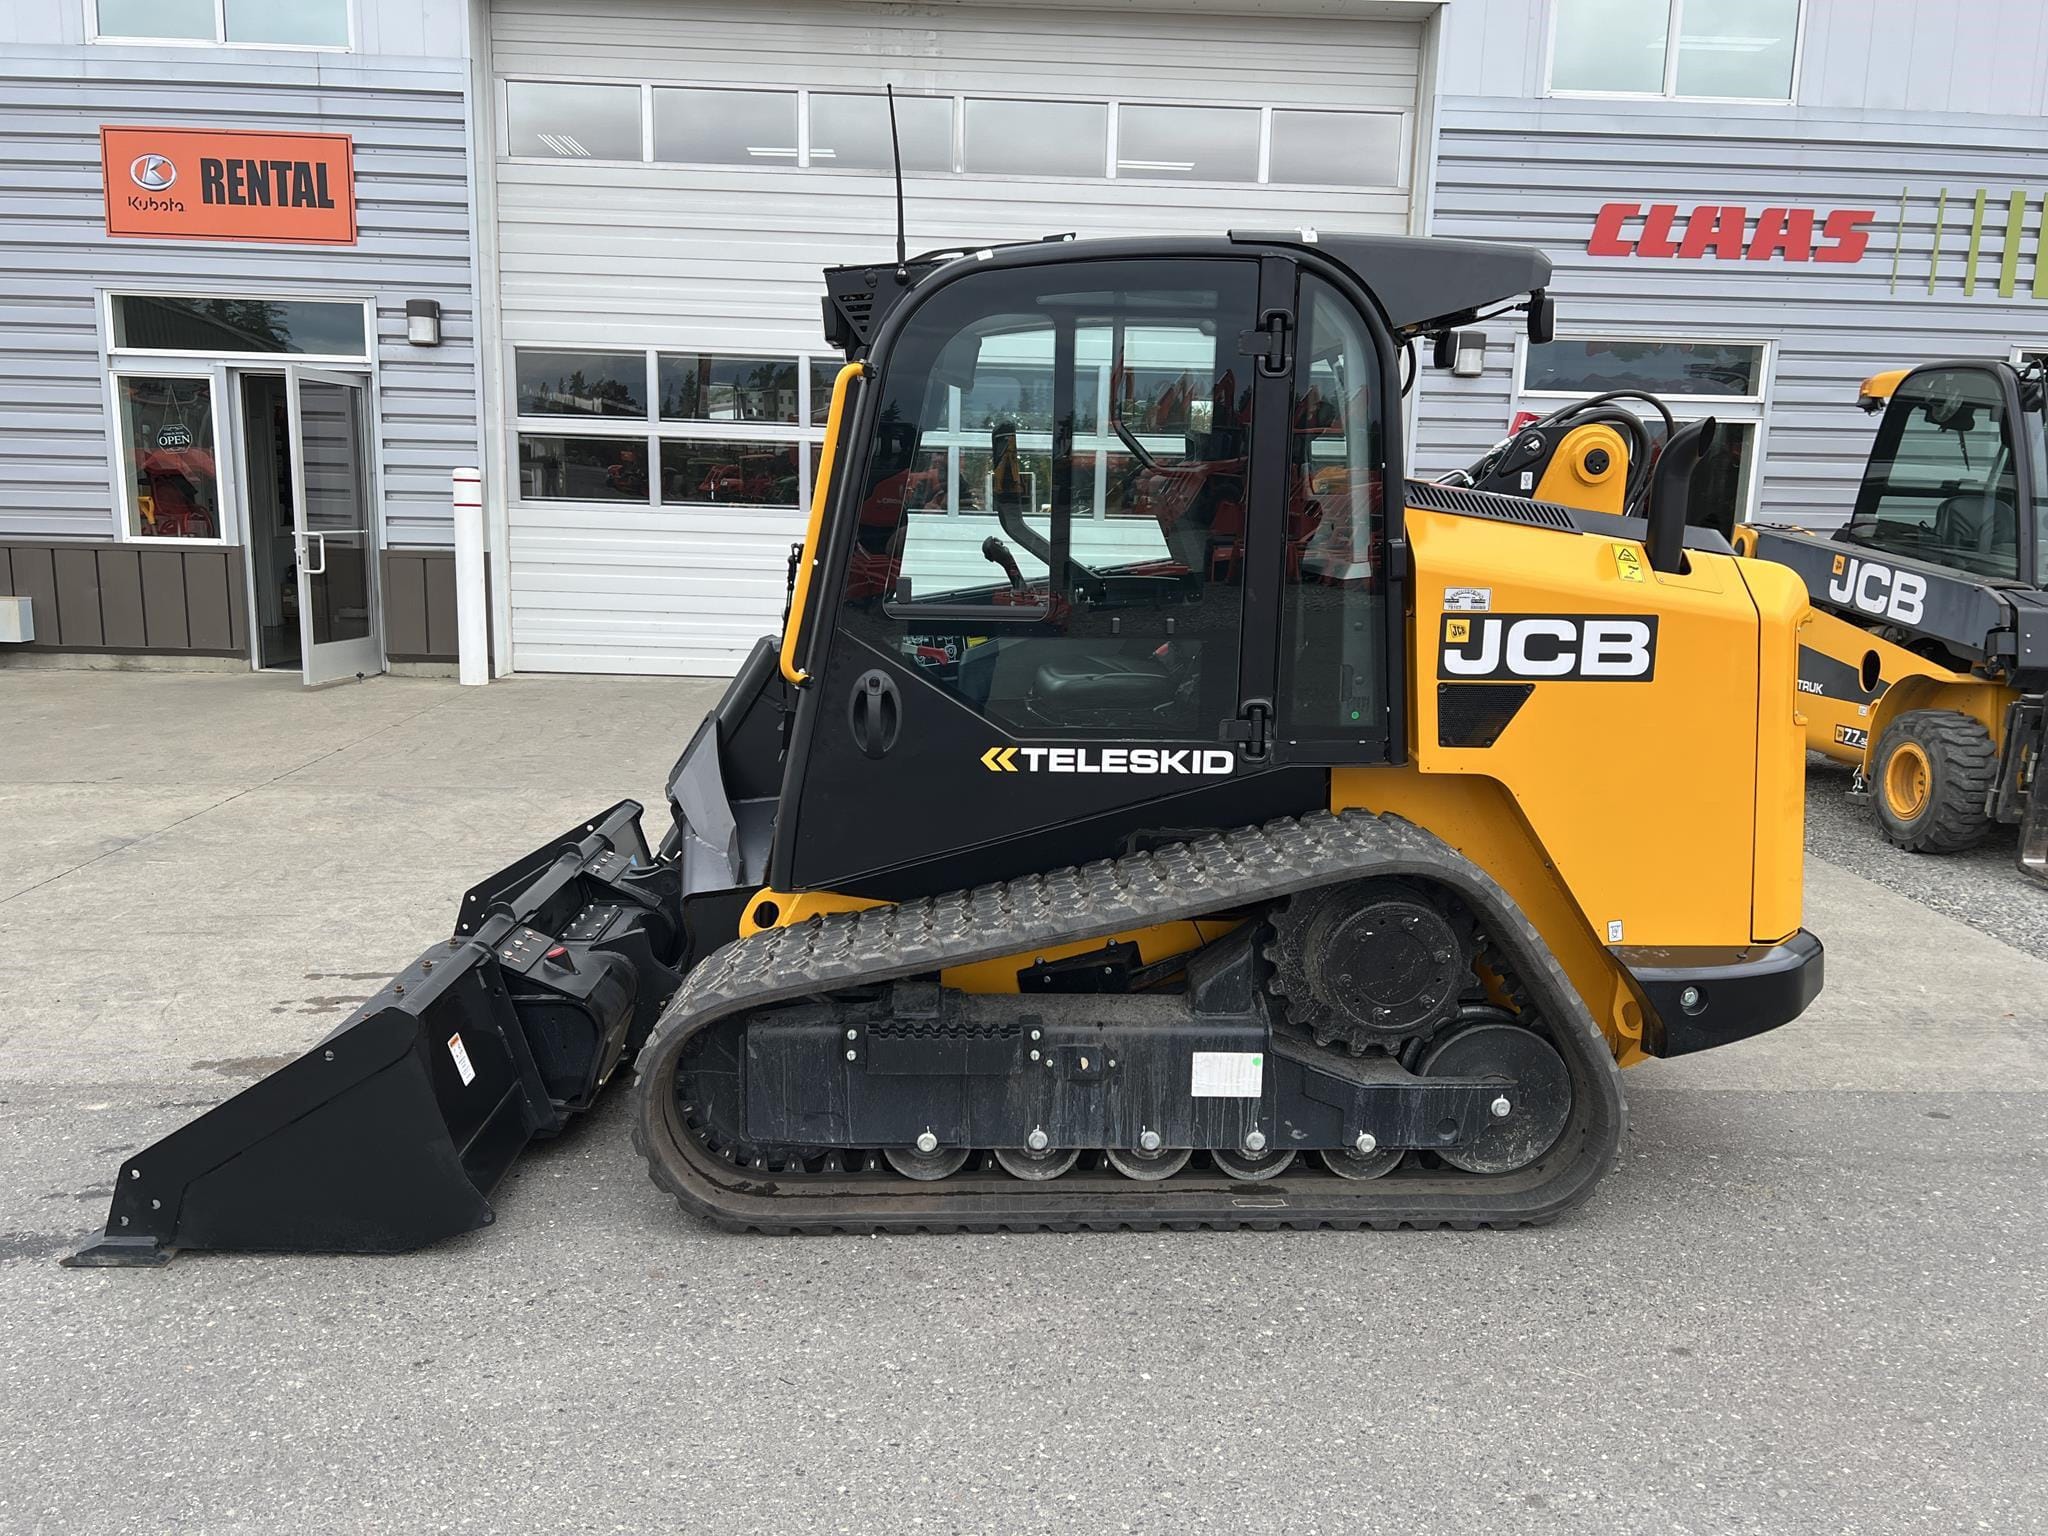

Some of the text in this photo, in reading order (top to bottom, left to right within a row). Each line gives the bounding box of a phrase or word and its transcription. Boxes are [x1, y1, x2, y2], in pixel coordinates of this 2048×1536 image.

[200, 157, 335, 209] RENTAL
[127, 196, 184, 212] Kubota
[1587, 203, 1875, 263] CLAAS
[159, 435, 190, 446] OPEN
[1829, 558, 1927, 625] JCB
[1444, 619, 1651, 676] JCB
[1450, 624, 1467, 638] JCB
[1020, 747, 1234, 775] TELESKID
